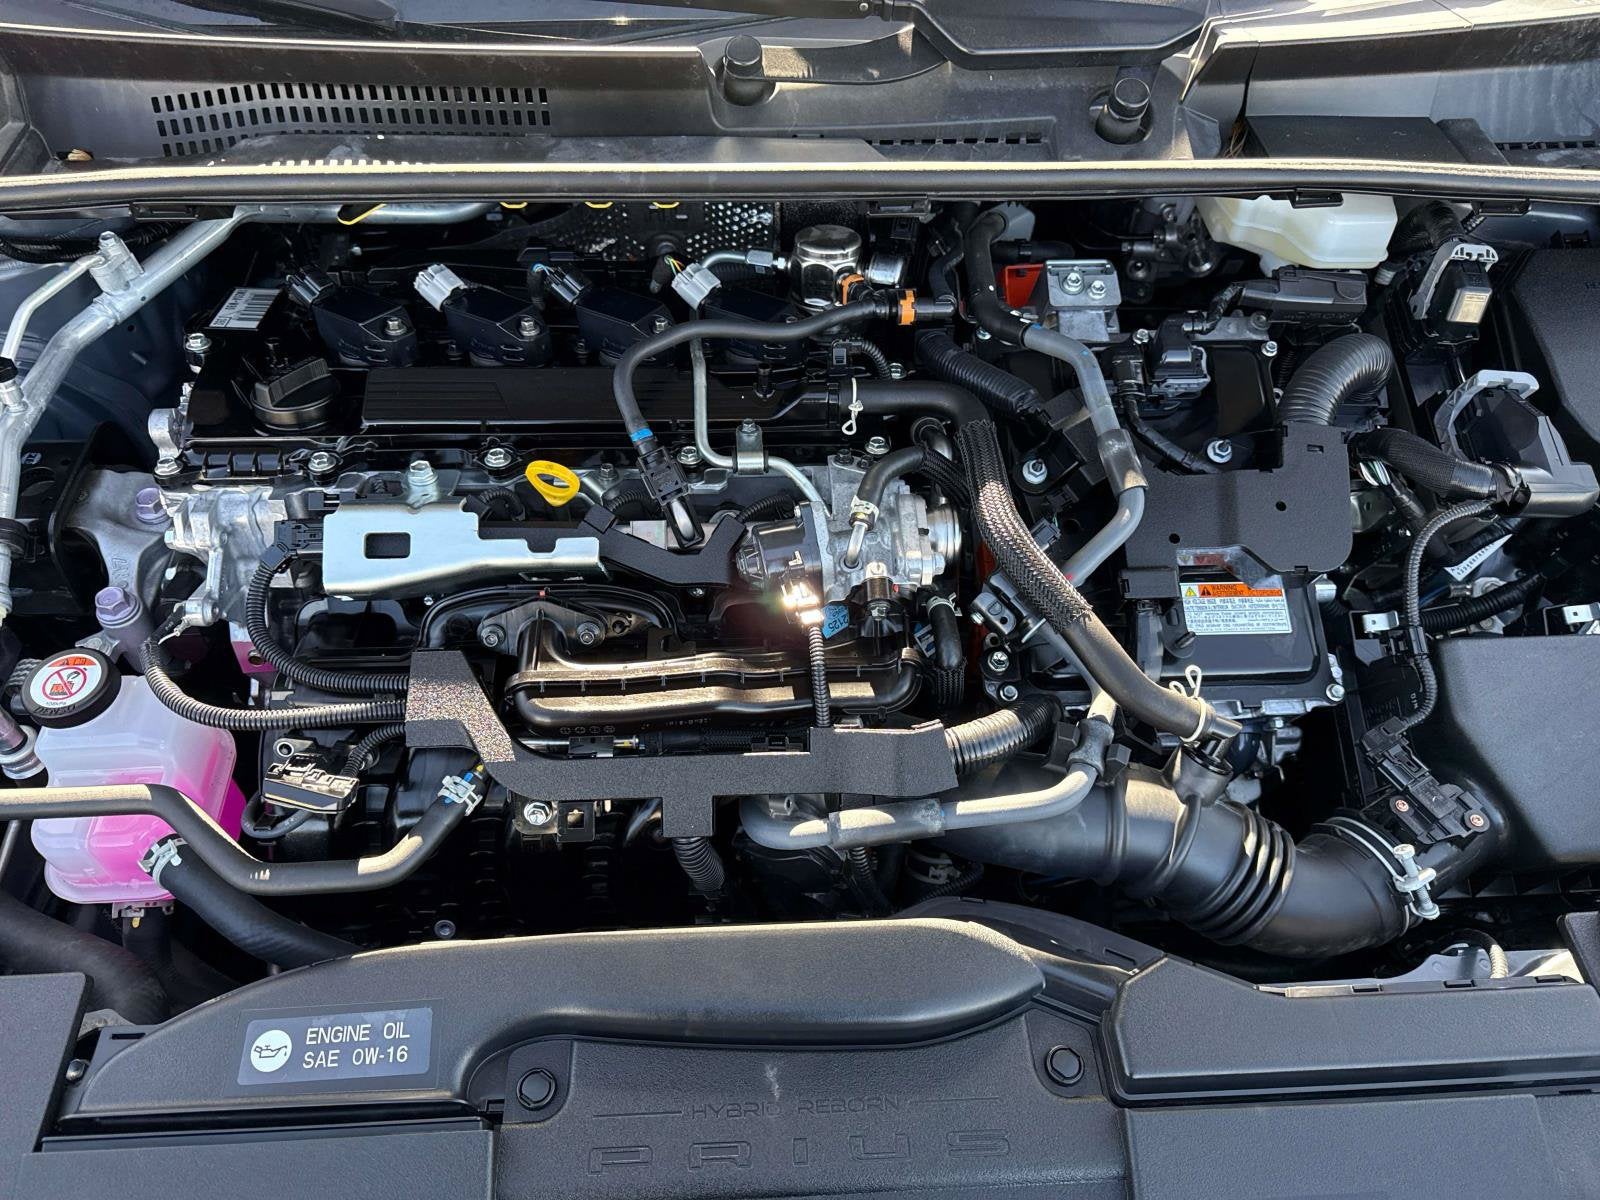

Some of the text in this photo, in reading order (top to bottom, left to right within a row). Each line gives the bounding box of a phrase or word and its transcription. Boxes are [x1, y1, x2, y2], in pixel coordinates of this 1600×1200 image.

[305, 1022, 411, 1045] ENGINE OIL
[302, 1045, 409, 1069] SAE 0W-16
[691, 1096, 900, 1119] HYBRID REBORN
[588, 1129, 1010, 1176] PRIUS
